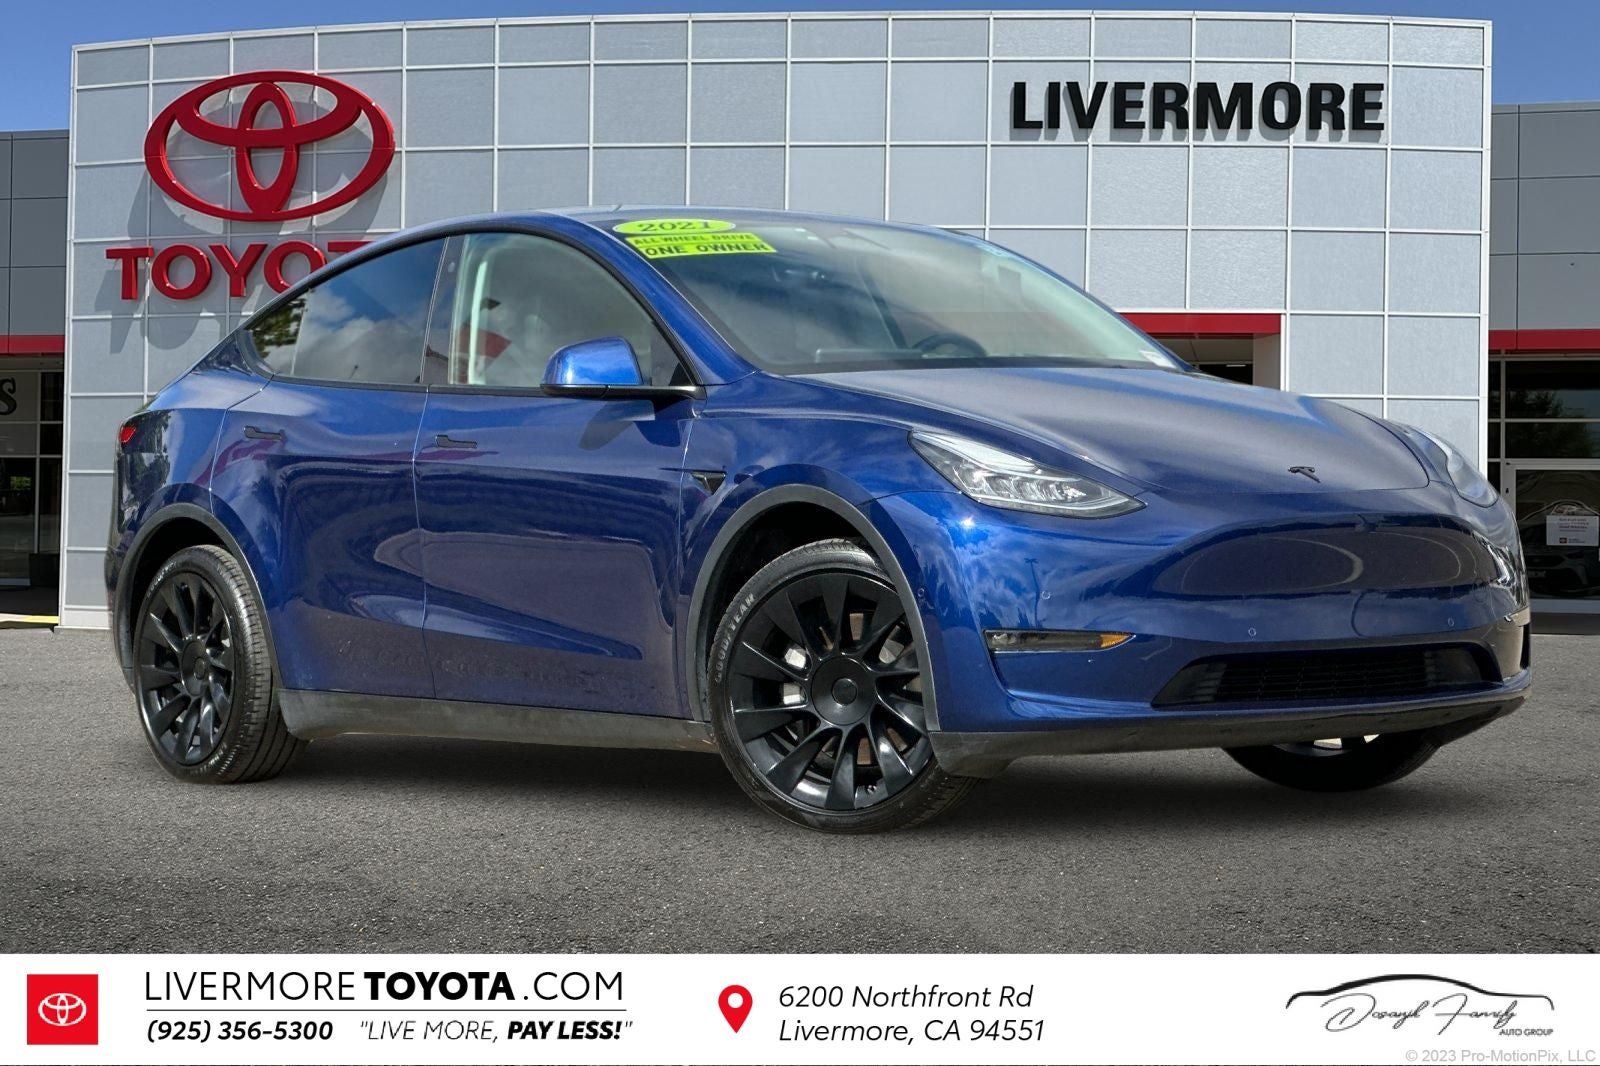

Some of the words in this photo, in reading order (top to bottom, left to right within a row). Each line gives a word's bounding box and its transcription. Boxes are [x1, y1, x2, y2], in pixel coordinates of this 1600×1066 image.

[1013, 81, 1385, 131] LIVERMORE
[638, 220, 712, 232] 2021
[633, 237, 656, 245] ALL
[663, 234, 706, 242] WHEEL
[711, 233, 755, 241] DRIVE
[645, 245, 687, 256] ONE
[695, 241, 767, 252] OWNER
[105, 240, 376, 300] TOYO
